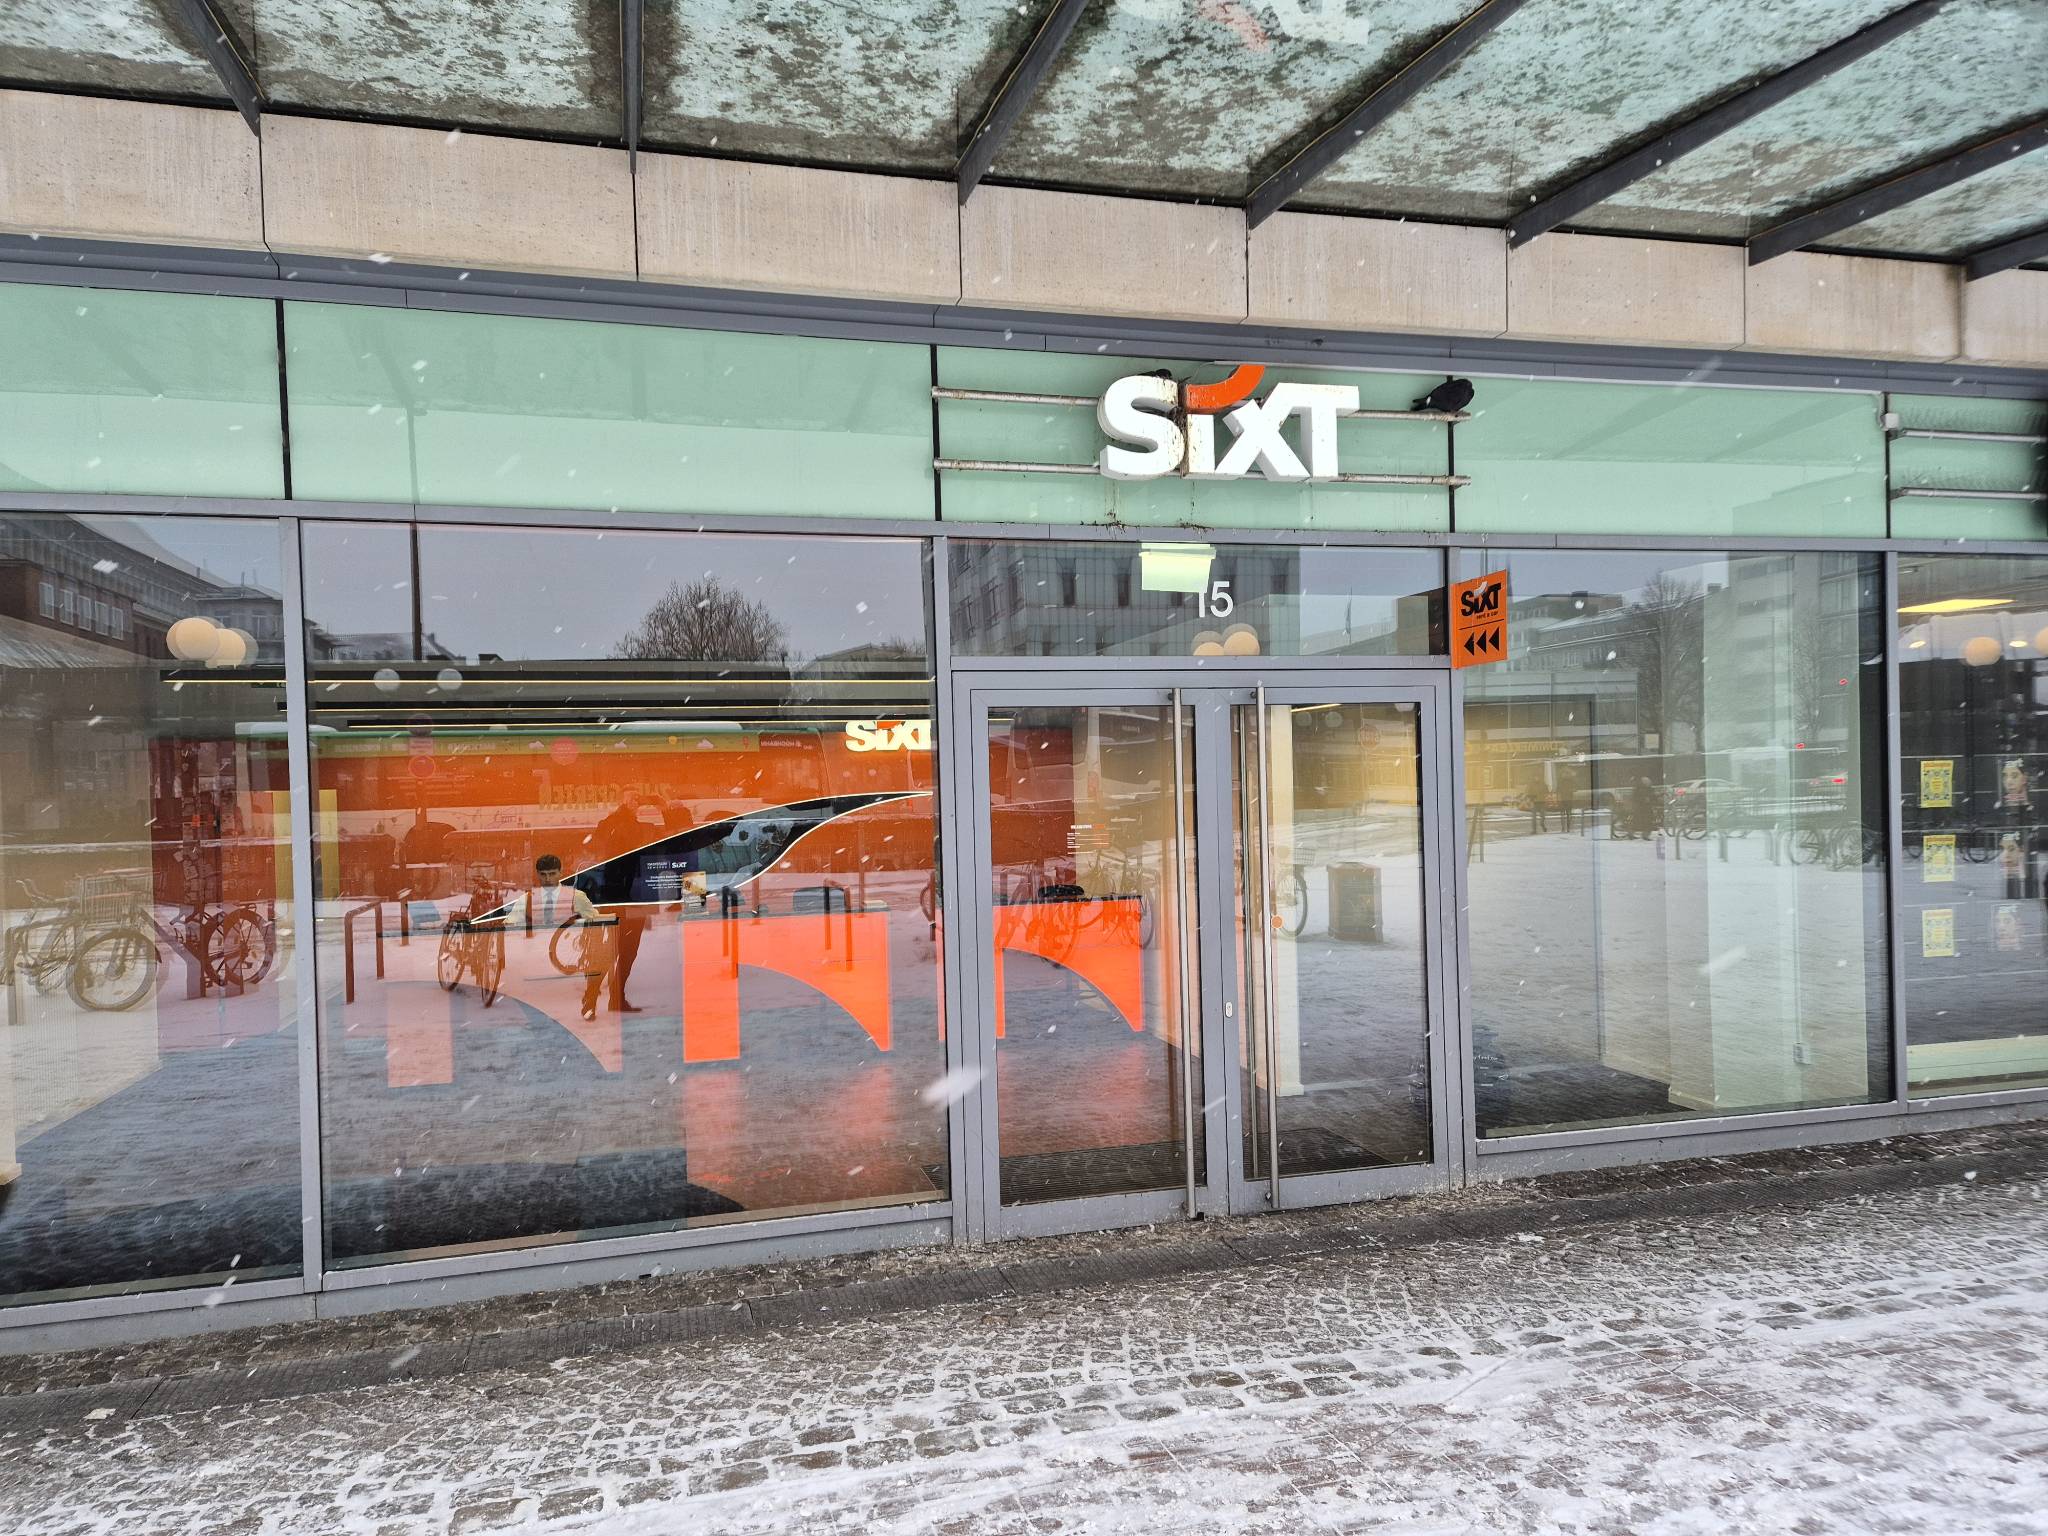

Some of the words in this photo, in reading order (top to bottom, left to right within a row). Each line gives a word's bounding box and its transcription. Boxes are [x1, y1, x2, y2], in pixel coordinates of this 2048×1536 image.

[1098, 364, 1360, 481] SIXT
[1199, 580, 1233, 618] 15
[1461, 581, 1502, 617] SIXT
